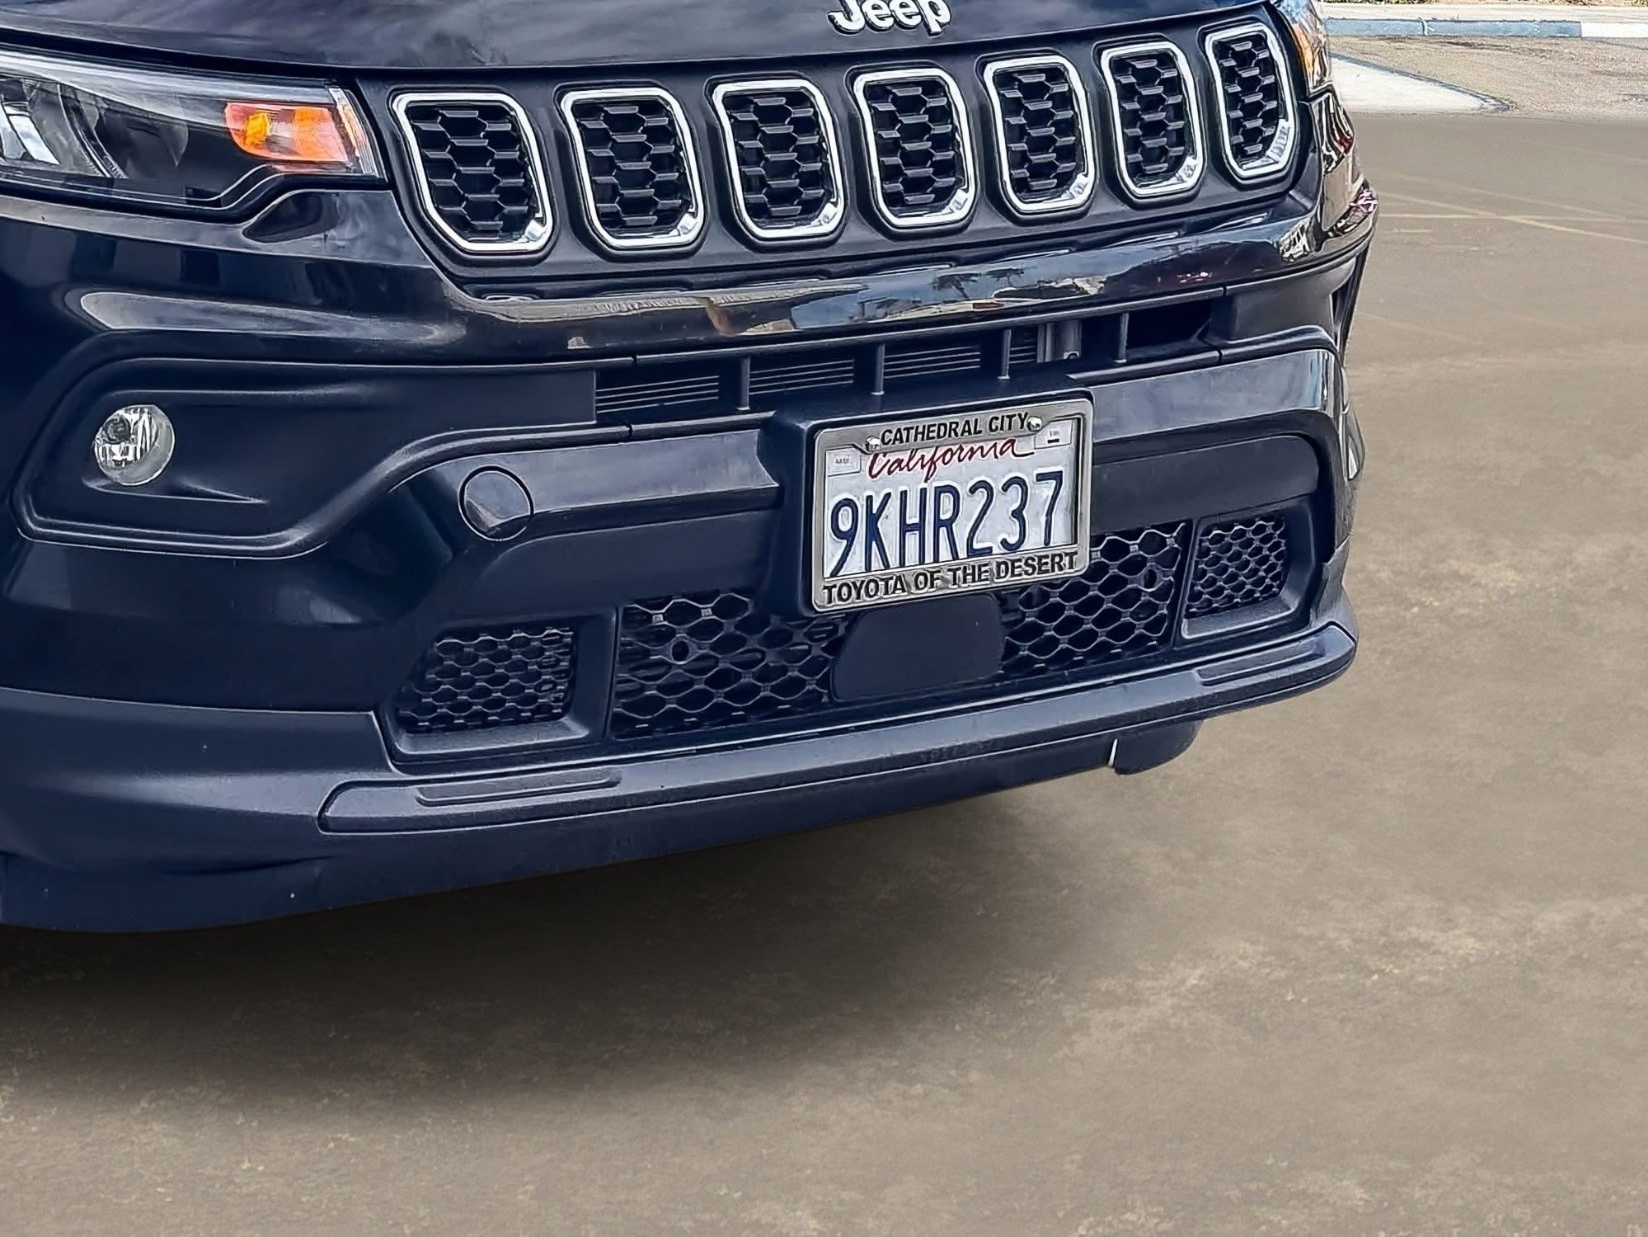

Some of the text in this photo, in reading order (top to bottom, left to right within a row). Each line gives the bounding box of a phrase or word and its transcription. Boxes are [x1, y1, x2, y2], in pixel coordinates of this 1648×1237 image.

[880, 412, 1029, 447] CATHEDRAL CITY
[867, 437, 1035, 483] California
[829, 468, 1064, 577] 9KHR237
[822, 551, 1079, 605] TOYOTA OF THE DESERT
